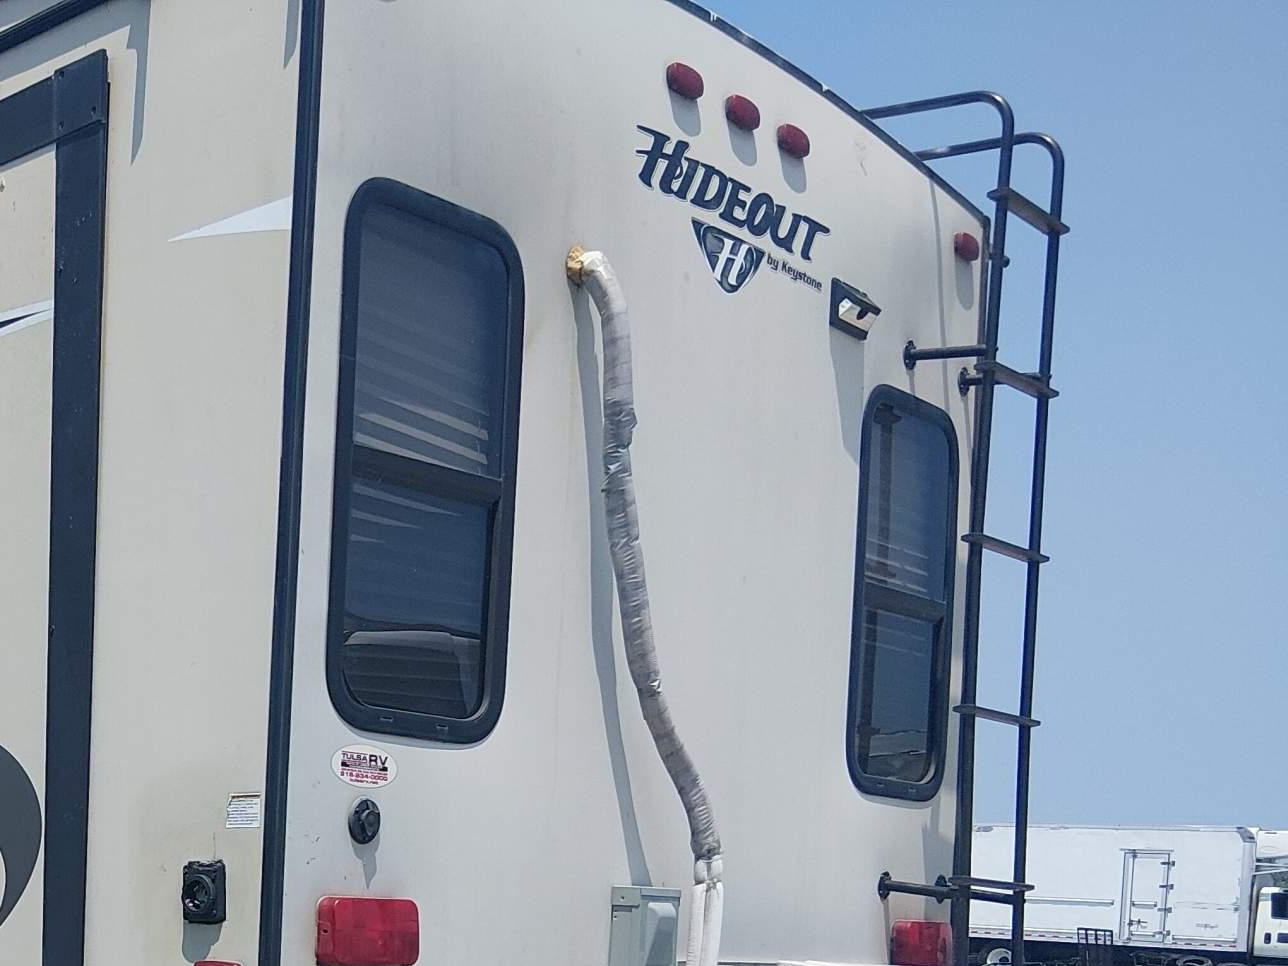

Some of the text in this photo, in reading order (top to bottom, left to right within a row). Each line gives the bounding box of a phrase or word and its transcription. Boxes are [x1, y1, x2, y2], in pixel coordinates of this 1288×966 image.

[635, 124, 831, 262] HIDEOUT
[767, 253, 823, 292] by Keystone
[368, 754, 389, 768] RV
